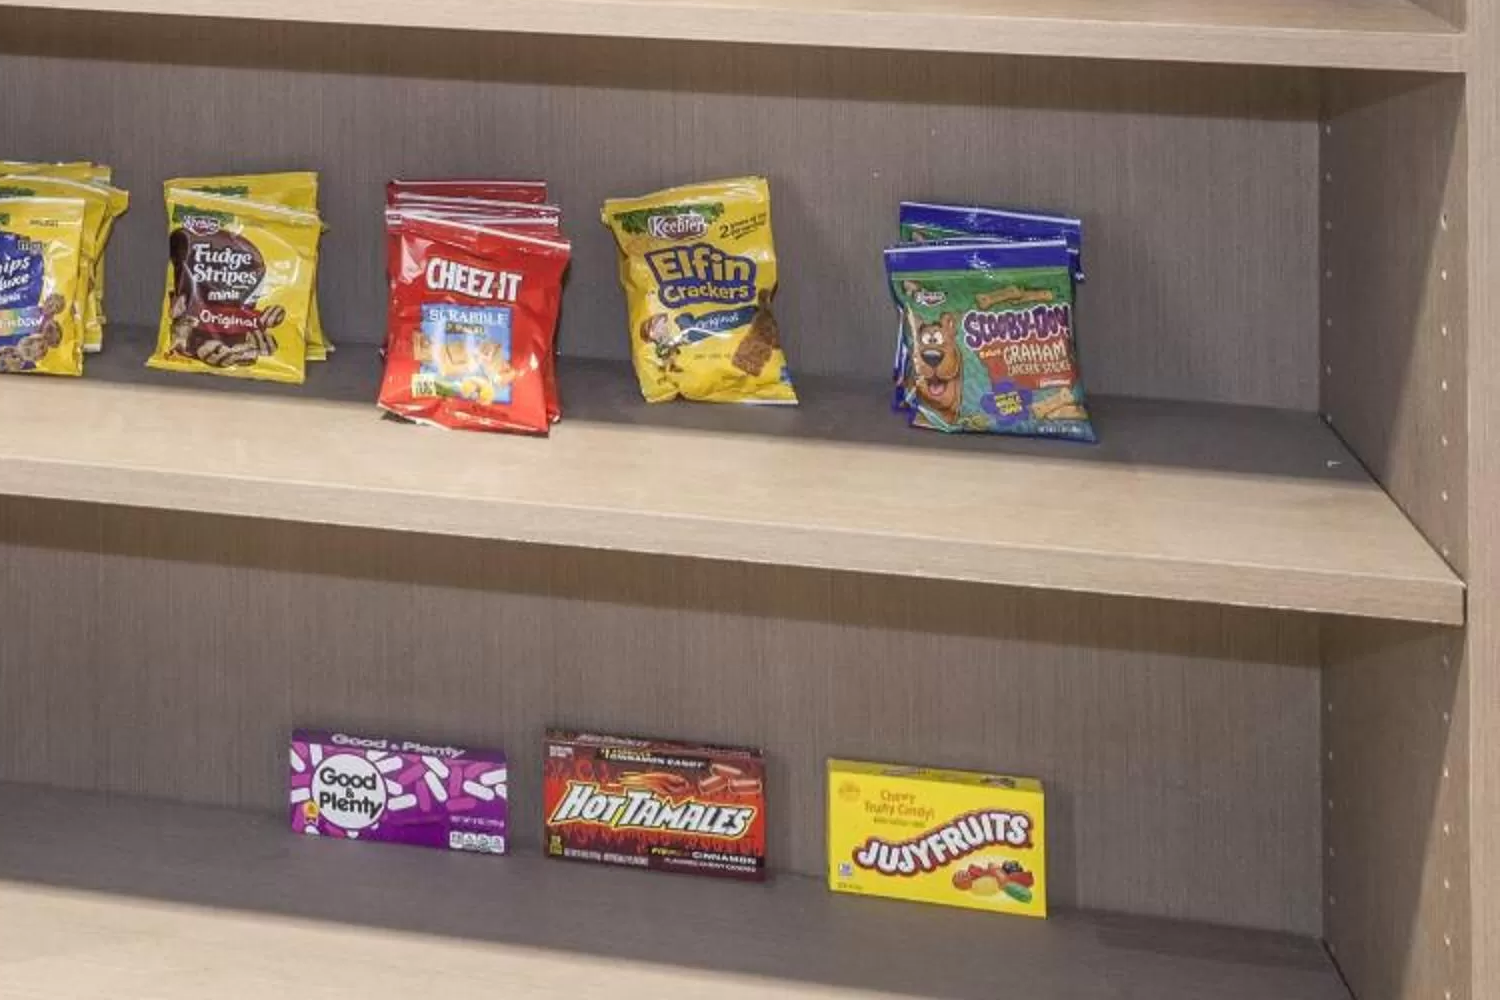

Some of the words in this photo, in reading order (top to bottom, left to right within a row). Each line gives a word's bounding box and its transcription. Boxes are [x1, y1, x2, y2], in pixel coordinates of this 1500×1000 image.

[652, 213, 703, 237] Keebler
[192, 243, 253, 270] Fudge
[653, 246, 751, 284] Elfin
[192, 263, 259, 286] Stripes
[199, 309, 258, 329] Original
[1003, 338, 1067, 364] GRAHAM
[330, 733, 388, 749] Good
[402, 741, 466, 759] Plenty
[319, 766, 377, 791] Good
[319, 790, 383, 819] Plenty
[552, 783, 625, 823] HOT
[618, 789, 753, 836] TAMALES
[857, 812, 1030, 873] JUJYFRUITS
